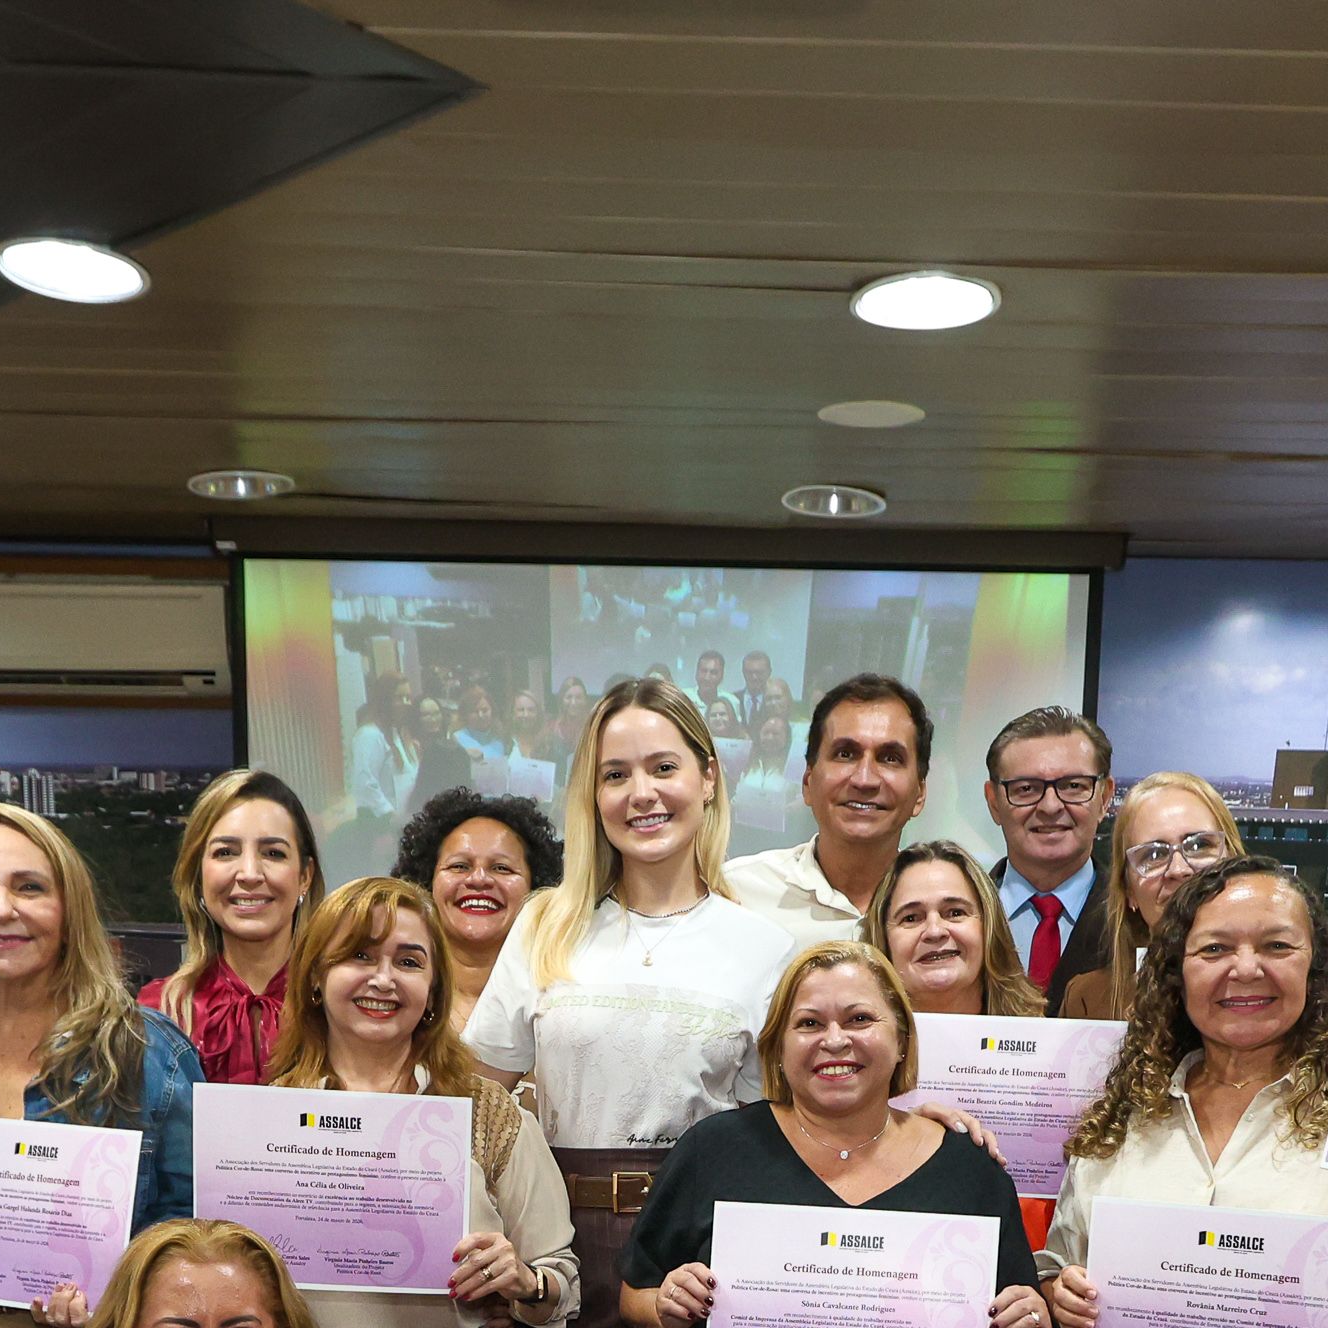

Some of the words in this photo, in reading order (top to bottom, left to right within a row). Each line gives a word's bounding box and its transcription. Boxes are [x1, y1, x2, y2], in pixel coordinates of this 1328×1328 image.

[997, 1040, 1037, 1053] ASSALCE
[948, 1065, 997, 1075] Certificado
[999, 1067, 1010, 1076] de
[1012, 1068, 1066, 1080] Homenagem
[1025, 1100, 1053, 1108] Medeiros
[319, 1115, 362, 1130] ASSALCE
[27, 1145, 59, 1159] ASSALCE
[266, 1143, 320, 1155] Certificado
[322, 1146, 333, 1156] de
[336, 1147, 396, 1160] Homenagem
[26, 1173, 36, 1182] de
[36, 1174, 80, 1188] Homenagem
[295, 1180, 309, 1188] Ana
[310, 1181, 327, 1189] Célia
[338, 1182, 365, 1191] Oliveira
[840, 1235, 884, 1249] ASSALCE
[1218, 1234, 1265, 1251] ASSALCE
[783, 1262, 840, 1275] Certificado
[841, 1266, 854, 1276] de
[856, 1267, 918, 1281] Homenagem
[1160, 1261, 1218, 1276] Certificado
[1220, 1267, 1232, 1277] de
[1234, 1268, 1300, 1285] Homenagem
[801, 1300, 821, 1308] Sônia
[822, 1301, 859, 1311] Cavalcante
[861, 1304, 896, 1314] Rodrigues
[1186, 1300, 1215, 1310] Rovânia
[1216, 1304, 1248, 1314] Marreiro
[1249, 1308, 1268, 1316] Cruz
